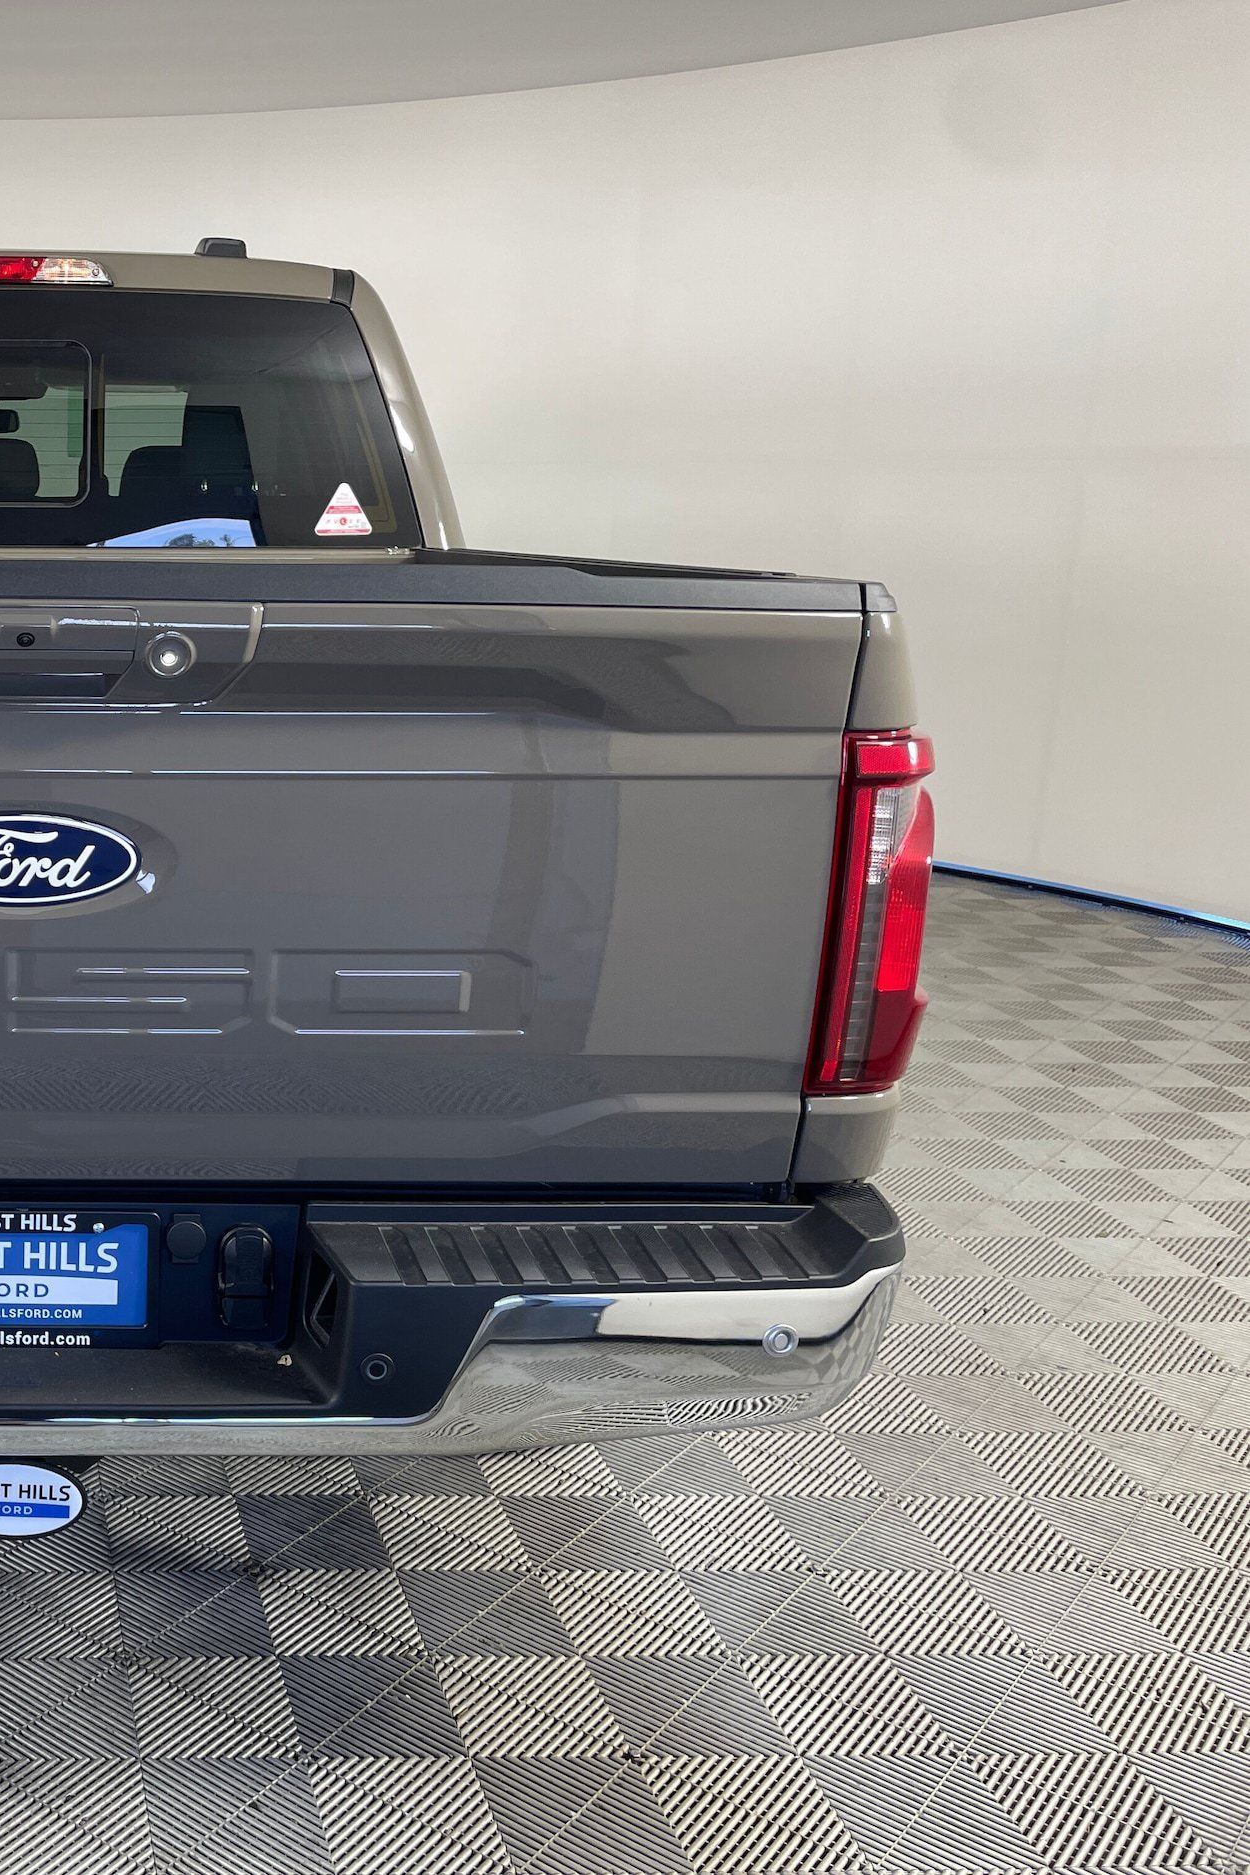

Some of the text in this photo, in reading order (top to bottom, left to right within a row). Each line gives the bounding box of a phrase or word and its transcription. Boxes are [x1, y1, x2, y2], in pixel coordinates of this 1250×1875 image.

[20, 1214, 77, 1232] HILLS
[23, 1241, 120, 1274] HILLS
[18, 1484, 71, 1501] HILLS
